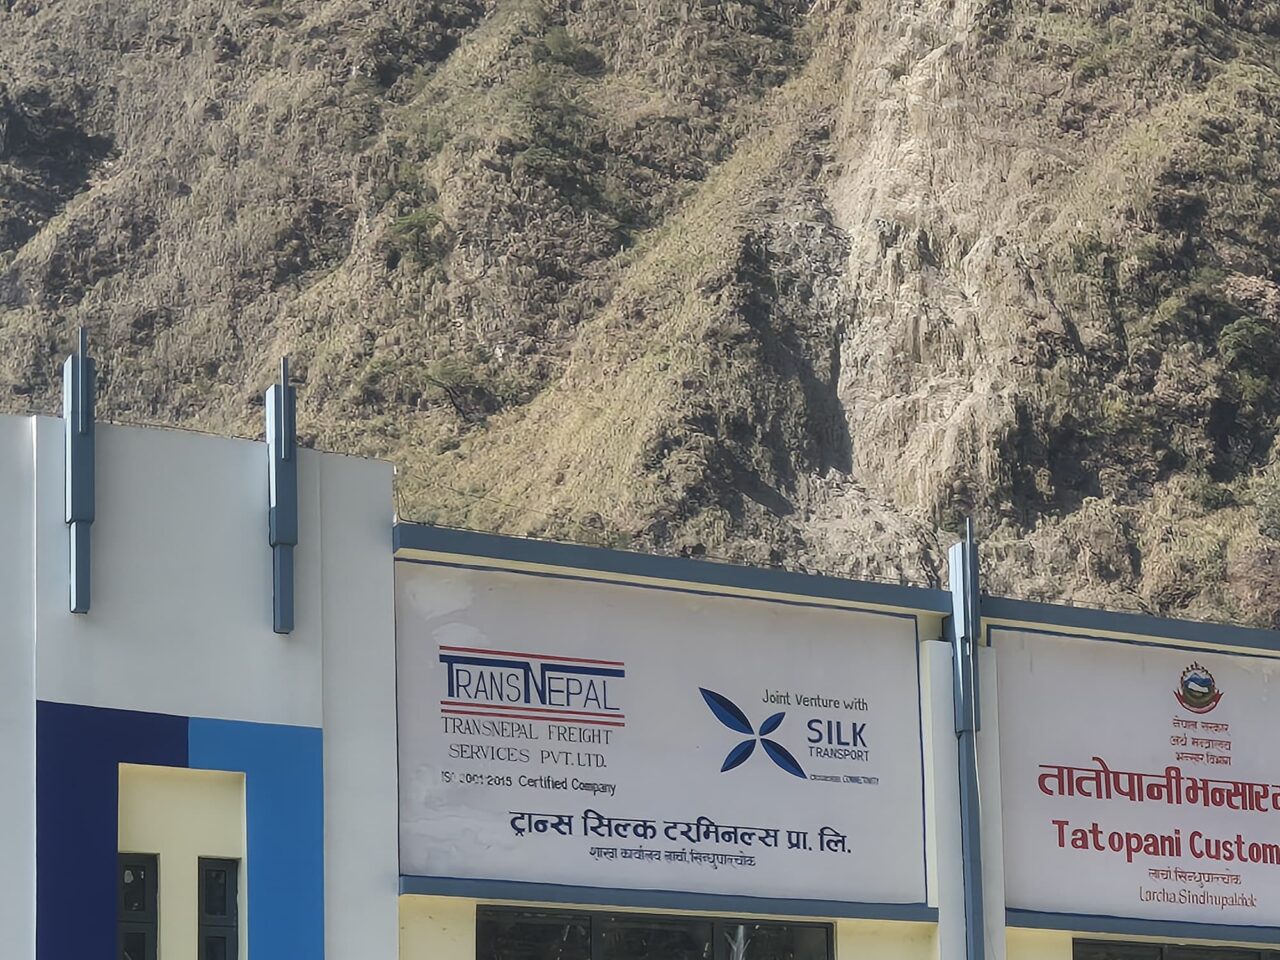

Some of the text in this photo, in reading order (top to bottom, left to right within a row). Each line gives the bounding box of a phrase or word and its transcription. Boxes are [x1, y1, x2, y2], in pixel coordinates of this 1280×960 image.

[762, 689, 869, 712] Joint Venture with
[441, 716, 613, 745] TRANSNEPAL FREIGHT
[807, 718, 868, 748] SILK
[449, 743, 530, 763] SERVICES
[809, 746, 870, 762] TRANSPORT
[441, 771, 455, 783] IS
[518, 775, 568, 790] Certified
[571, 778, 617, 796] Company
[1038, 757, 1184, 806] तातोपानी
[1186, 776, 1269, 814] भन्सार
[509, 808, 853, 854] ट्रान्स सिल्क टरमिनल्स प्रा. लि.
[1052, 820, 1182, 863] Tatopani
